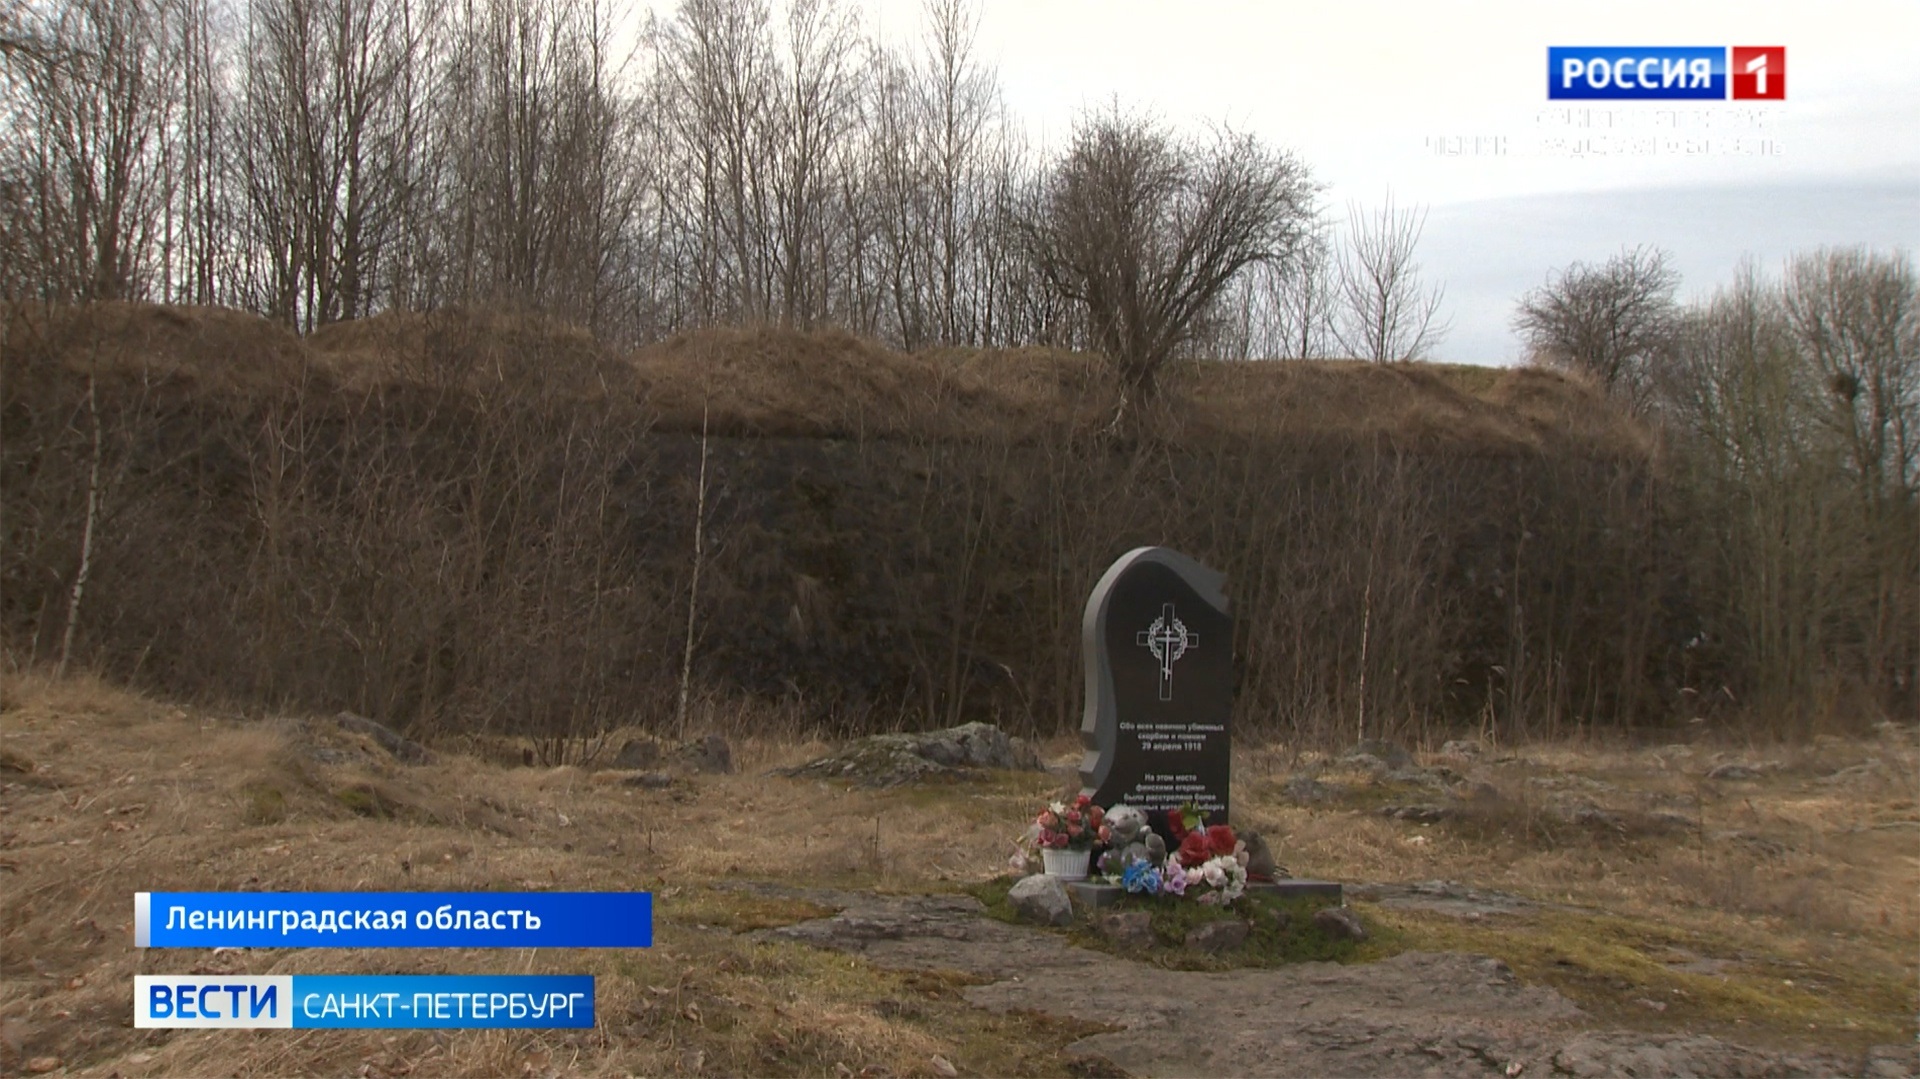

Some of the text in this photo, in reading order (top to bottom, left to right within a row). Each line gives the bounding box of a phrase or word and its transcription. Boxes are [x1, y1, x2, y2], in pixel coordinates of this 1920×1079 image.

[1120, 722, 1135, 730] Обо
[1184, 743, 1201, 751] 1918
[1136, 784, 1173, 792] финскими
